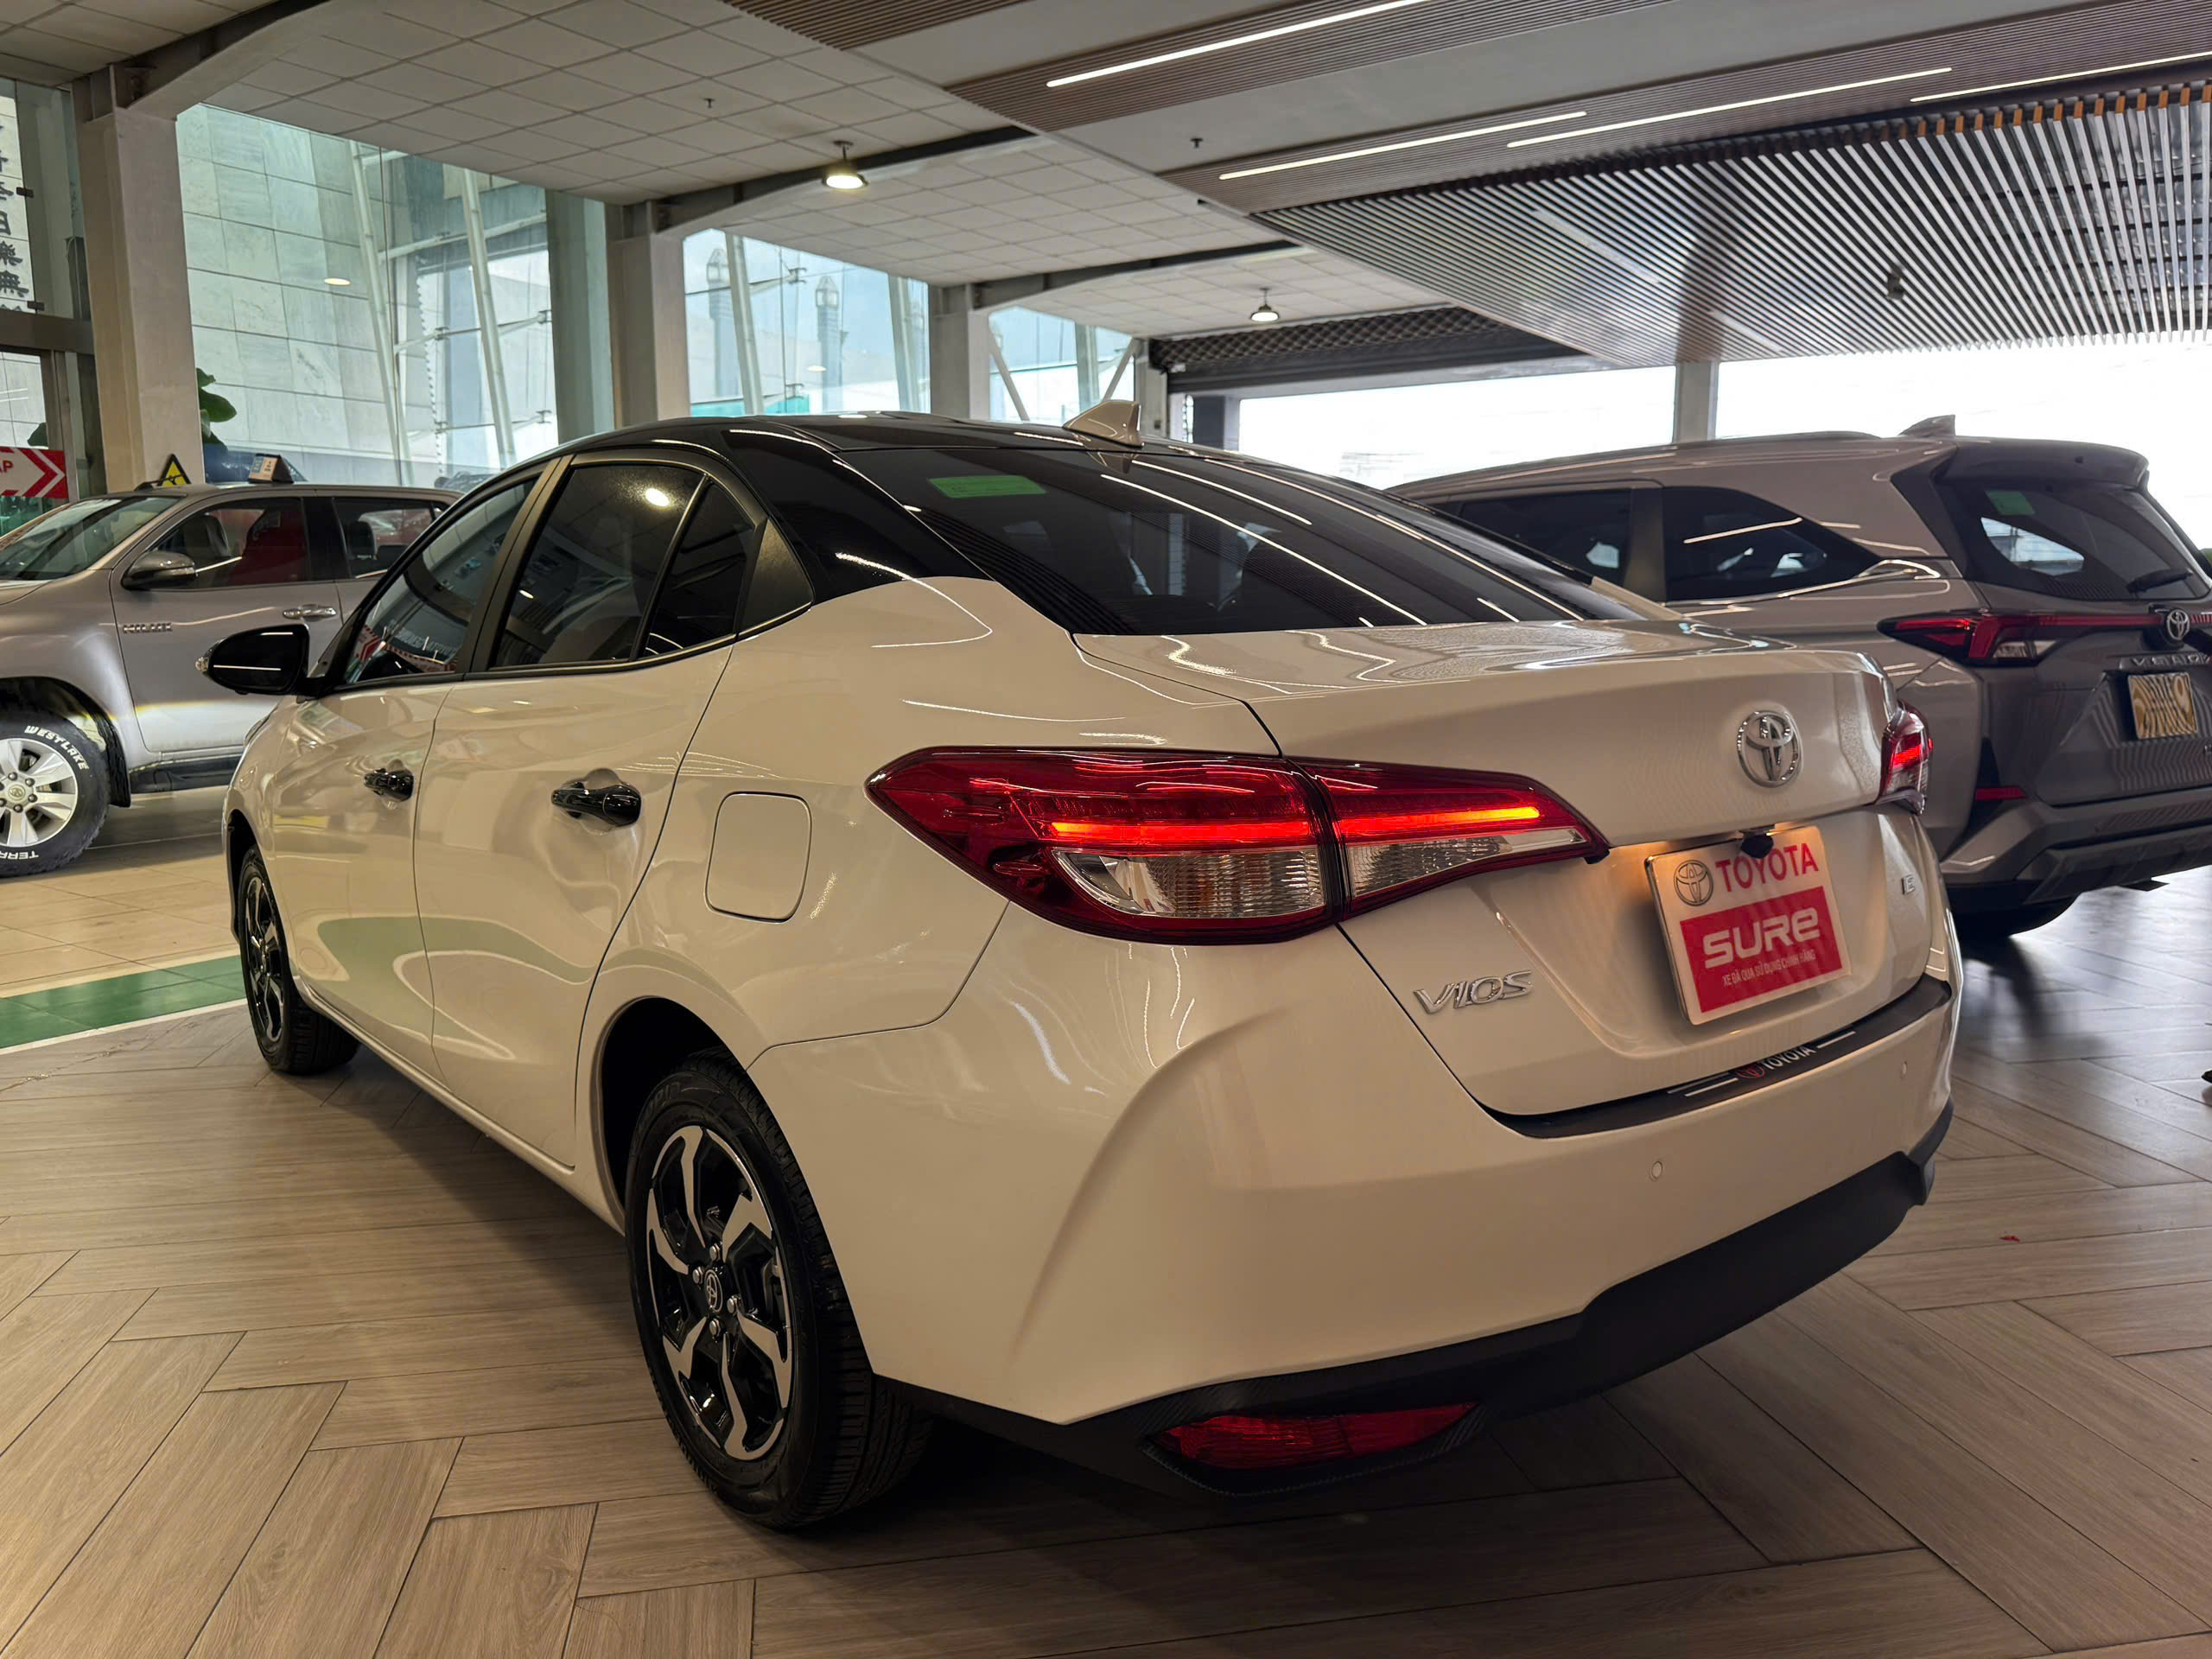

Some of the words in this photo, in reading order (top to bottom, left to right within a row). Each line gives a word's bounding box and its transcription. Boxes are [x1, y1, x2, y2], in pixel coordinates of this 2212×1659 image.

[24, 725, 89, 770] WESTLAKE
[1715, 842, 1819, 893] TOYOTA
[1413, 969, 1534, 1014] VIOS
[1763, 1046, 1817, 1070] TOYOTA
